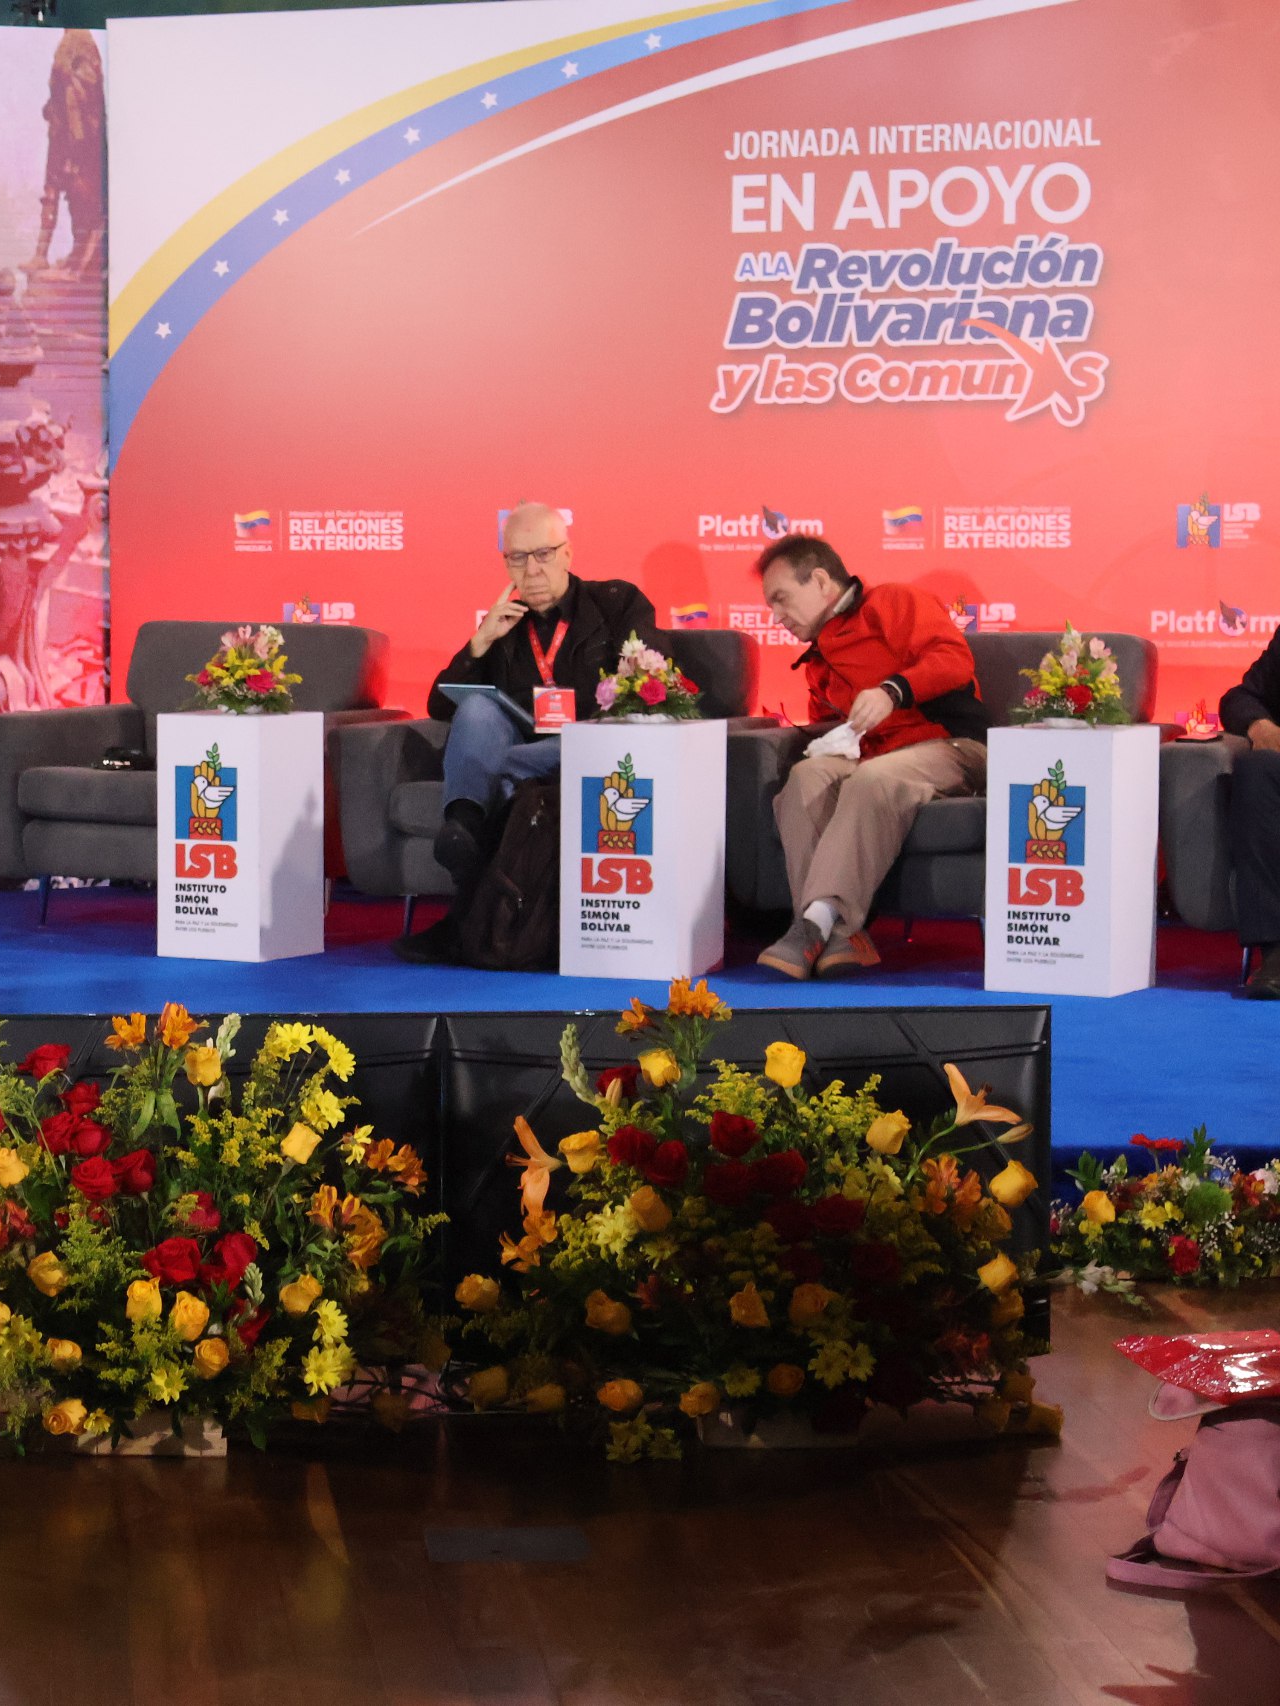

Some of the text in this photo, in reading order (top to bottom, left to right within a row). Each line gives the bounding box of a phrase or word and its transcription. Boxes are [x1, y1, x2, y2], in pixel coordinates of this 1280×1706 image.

[724, 118, 1101, 160] JORNADA INTERNACIONAL
[731, 162, 1091, 233] EN APOYO
[761, 254, 791, 277] LA
[795, 235, 1100, 291] Revolución
[725, 290, 1091, 347] Bolivariana
[711, 363, 758, 413] y
[755, 355, 837, 404] las
[289, 518, 403, 534] RELACIONES
[943, 515, 1071, 531] RELACIONES
[289, 535, 403, 550] EXTERIORES
[943, 532, 1071, 548] EXTERIORES
[175, 883, 227, 894] INSTITUTO
[175, 893, 209, 904] SIMÓN
[581, 898, 640, 909] INSTITUTO
[175, 905, 218, 916] BOLÍVAR
[581, 909, 620, 920] SIMÓN
[1007, 910, 1071, 922] INSTITUTO
[581, 921, 631, 933] BOLÍVAR
[1007, 921, 1049, 933] SIMÓN
[1007, 934, 1060, 946] BOLÍVAR
